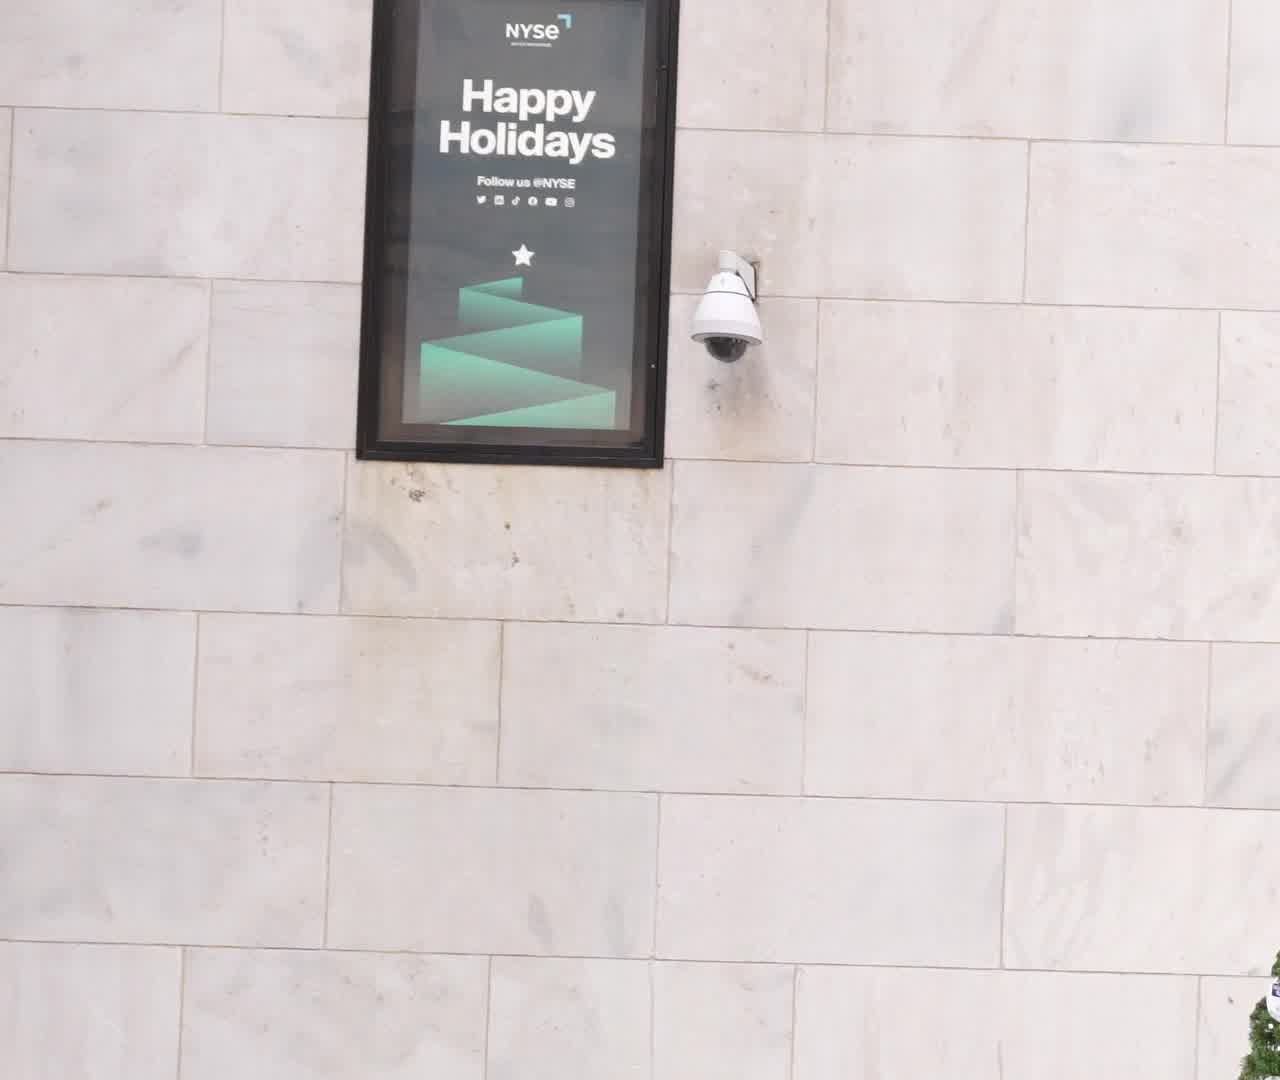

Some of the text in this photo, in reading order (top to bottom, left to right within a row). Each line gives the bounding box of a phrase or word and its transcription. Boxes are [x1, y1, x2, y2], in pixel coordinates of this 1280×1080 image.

[462, 78, 597, 123] Happy
[439, 120, 616, 165] Holidays
[477, 175, 576, 189] Follow us @NYSE
